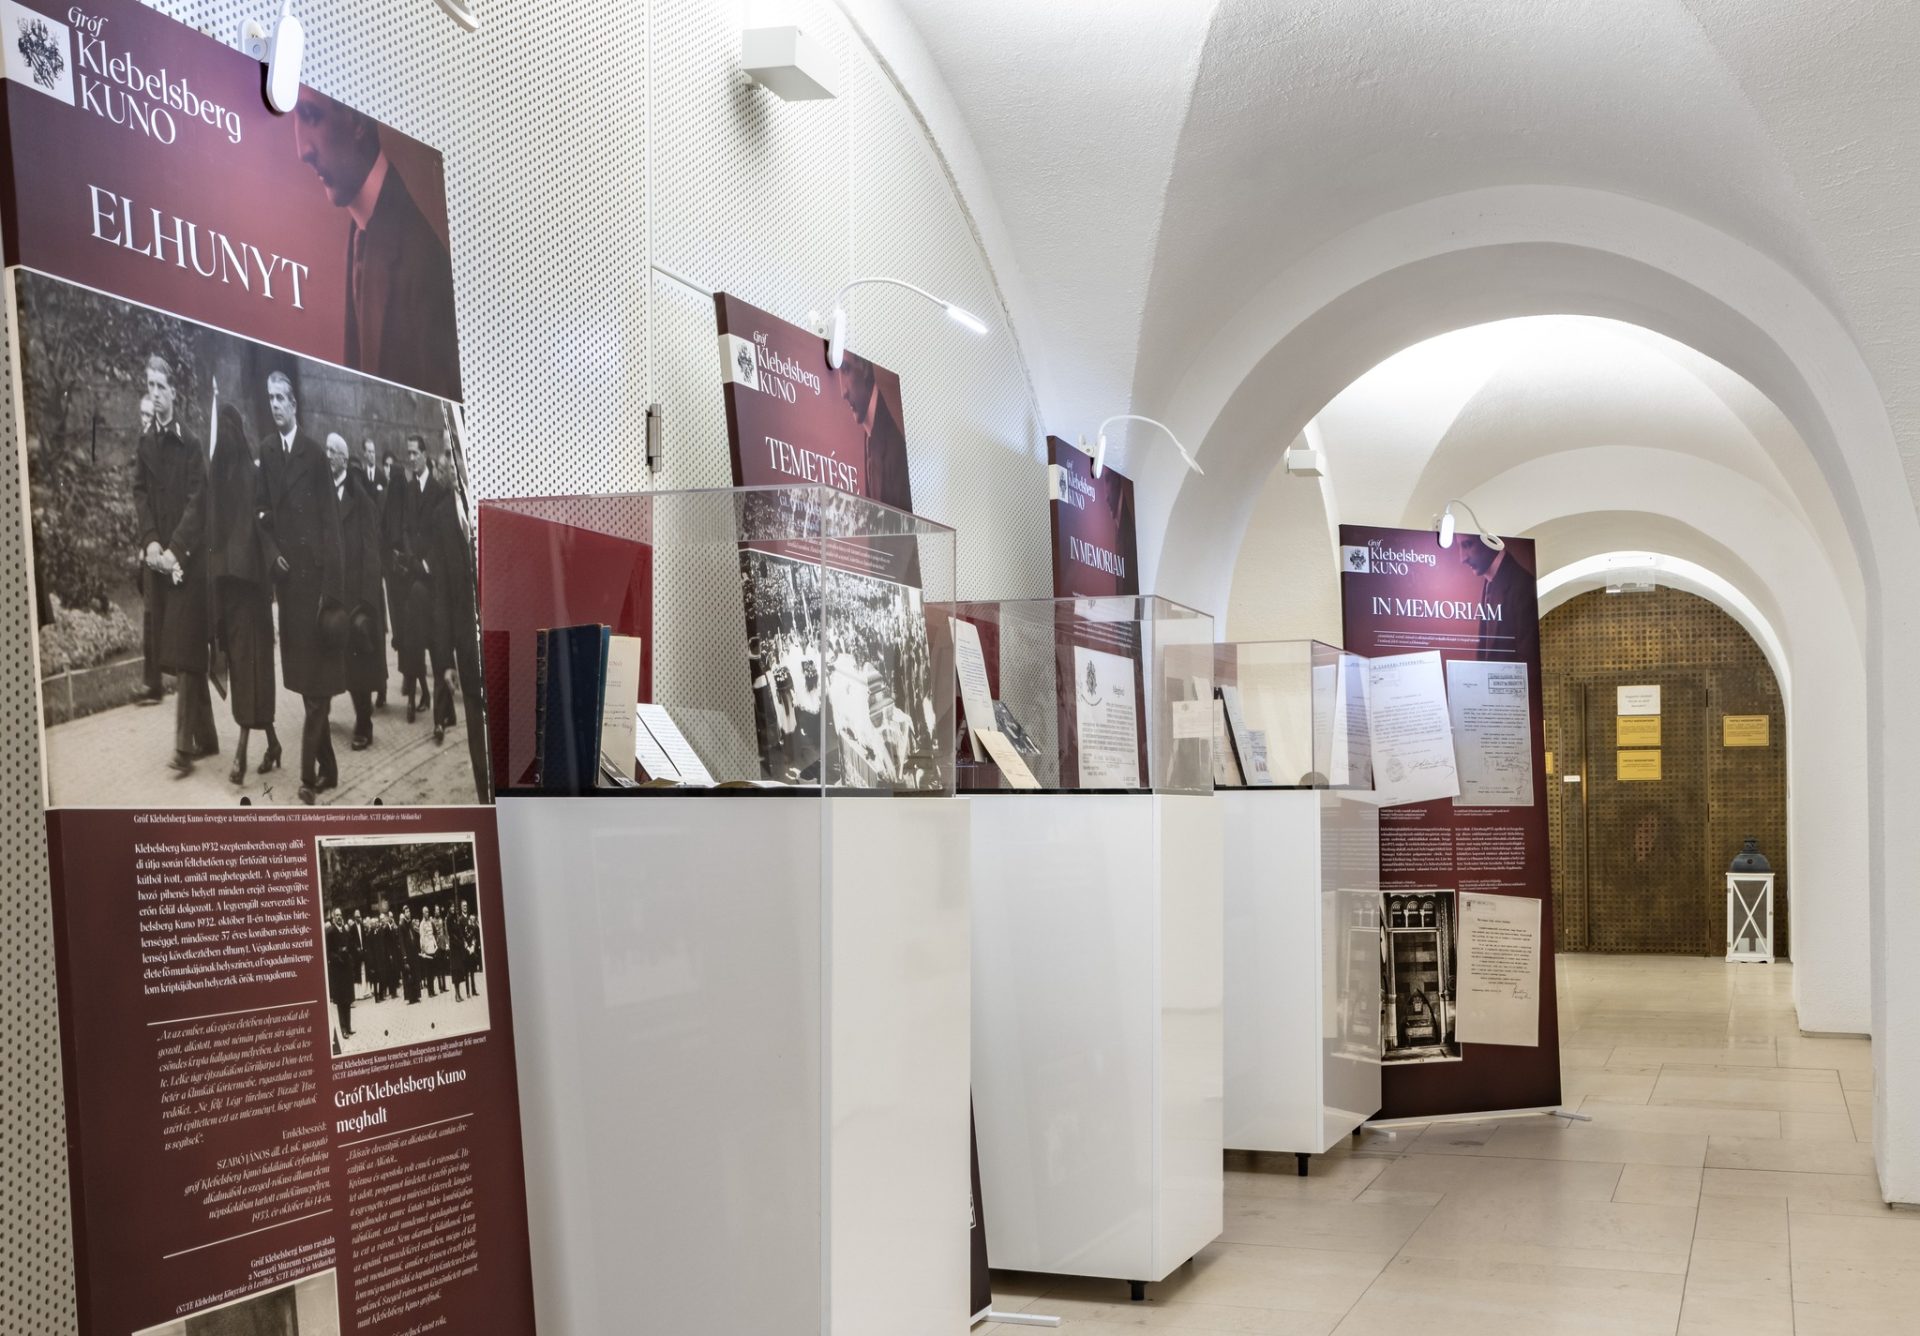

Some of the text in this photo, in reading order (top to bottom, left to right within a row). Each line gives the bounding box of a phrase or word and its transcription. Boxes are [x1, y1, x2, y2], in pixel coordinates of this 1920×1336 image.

[67, 6, 108, 36] Gróf
[77, 32, 242, 143] Klebelsberg
[79, 74, 176, 145] KUNO
[88, 184, 309, 310] ELHUNYT
[753, 330, 769, 347] Gróf
[757, 345, 820, 396] Klebelsberg
[760, 371, 796, 404] KUNO
[766, 436, 860, 495] TEMETÉSE
[1069, 470, 1096, 502] Klebelsberg
[1368, 539, 1381, 550] Gróf
[1371, 546, 1436, 566] Klebelsberg
[1070, 536, 1125, 579] IN MEMORIAM
[1371, 562, 1409, 576] KUNO
[1372, 597, 1503, 622] IN MEMORIAM
[134, 815, 149, 823] Gróf
[150, 815, 187, 824] Klebelsberg
[188, 815, 204, 823] Kuno
[135, 843, 180, 854] Klebelsberg
[181, 843, 201, 852] Kuno
[202, 842, 219, 851] 1932
[220, 841, 275, 853] szeptemberében
[276, 843, 288, 852] egy
[136, 859, 144, 869] di
[145, 859, 160, 871] útja
[162, 858, 184, 869] során
[185, 857, 225, 868] feltehetően
[226, 859, 237, 868] egy
[240, 855, 268, 865] fertőzött
[284, 854, 308, 865] tanyasi
[137, 868, 308, 885] kútból ivott, amitől megbetegedett. A gyógyulást
[138, 882, 310, 902] hozó pihenés helyett minden erejét összegyűjtve
[139, 896, 310, 916] erőn felül dolgozott. A legyengült szervezetű Kle-
[140, 921, 174, 932] belsberg
[175, 920, 196, 930] Kuno
[218, 916, 245, 926] október
[265, 912, 292, 923] tragikus
[181, 933, 220, 945] mindössze
[232, 931, 248, 940] éves
[249, 928, 278, 939] korában
[142, 952, 168, 964] lenség
[170, 948, 222, 962] következtében
[223, 945, 251, 956] elhunyt.
[292, 939, 313, 950] szerint
[144, 968, 162, 979] élete
[171, 963, 216, 977] munkájának
[260, 954, 296, 968] Fogadalmi
[145, 970, 298, 995] lom kriptájában helyezték örök nyugalomra.
[334, 1069, 467, 1108] Gróf Klebelsberg Kuno
[336, 1106, 388, 1133] meghalt
[217, 1152, 245, 1170] SZABÓ
